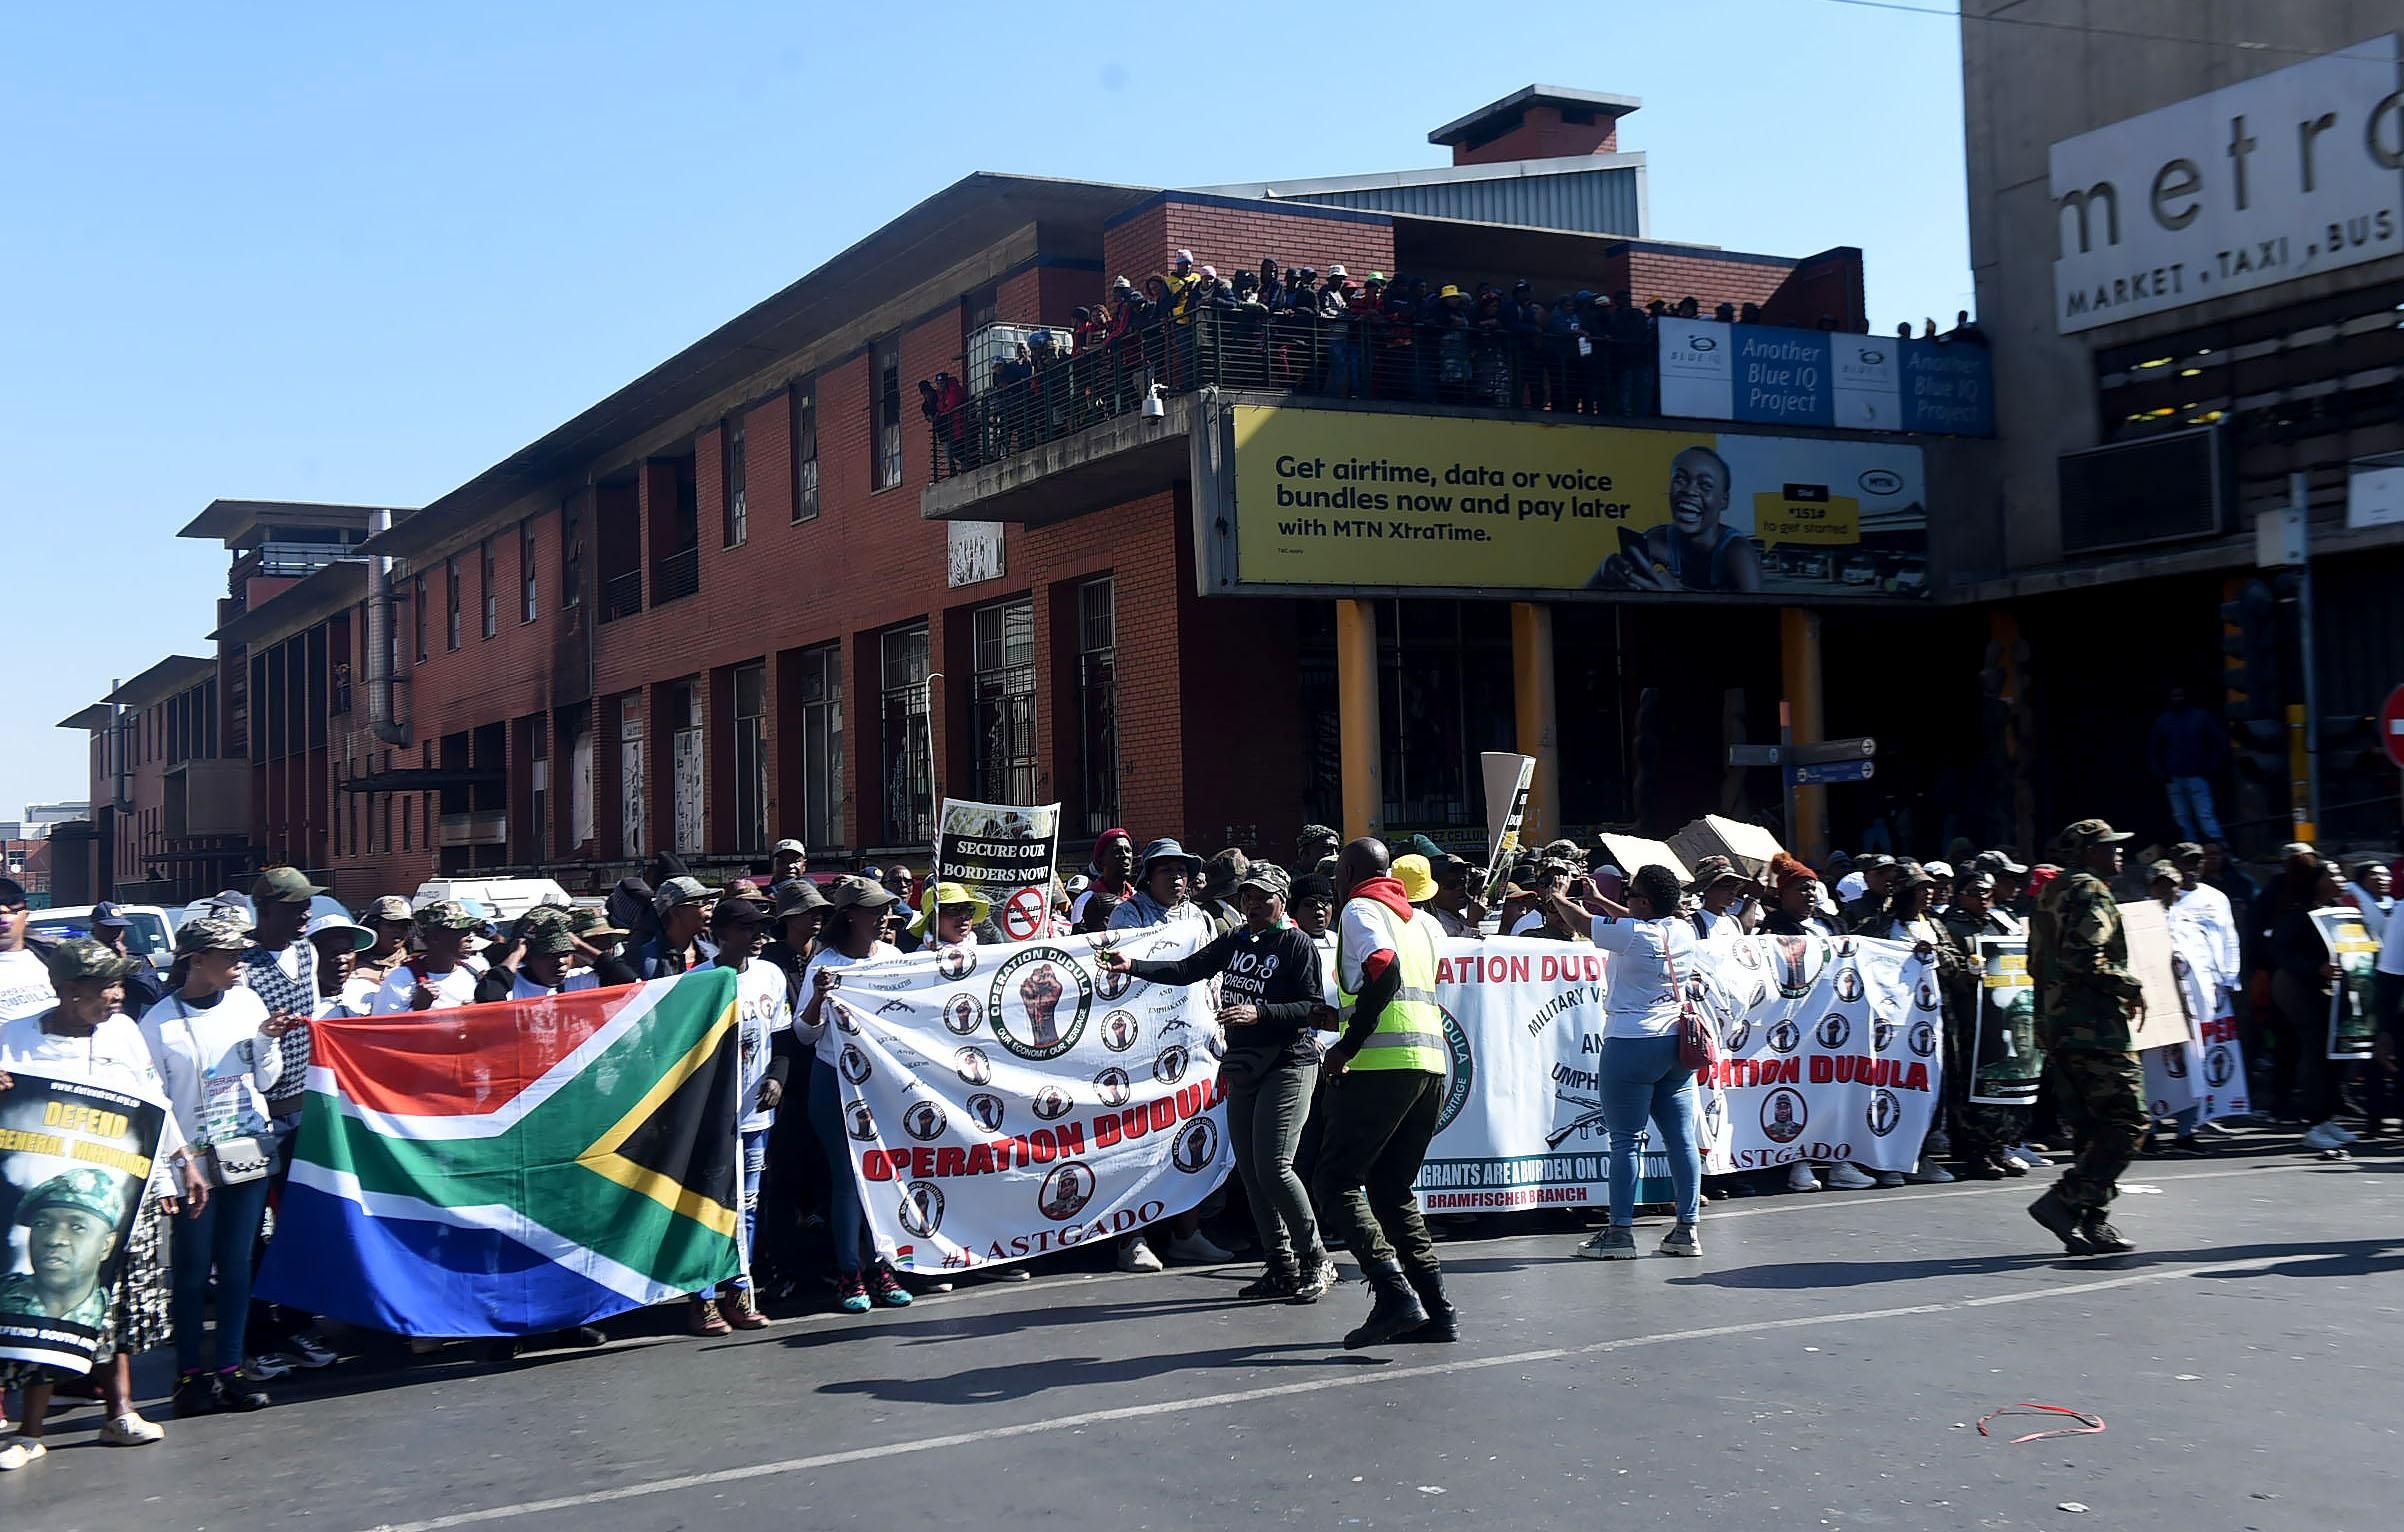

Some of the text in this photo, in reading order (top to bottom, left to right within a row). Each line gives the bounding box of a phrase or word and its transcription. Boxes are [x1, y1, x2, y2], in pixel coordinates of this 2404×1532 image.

[2051, 88, 2404, 255] metro
[2066, 209, 2394, 318] MARKET TAXI BUS
[1742, 337, 1821, 364] Another
[1747, 363, 1789, 387] Blue
[1795, 367, 1818, 391] IQ
[1750, 387, 1817, 417] Project
[1275, 455, 1613, 492] Get airtime, data or voice
[1276, 484, 1632, 523] bundles now and pay later
[1278, 517, 1493, 543] with MTN XtraTime.
[957, 840, 1046, 858] SECURE OUR
[942, 862, 1016, 881] BORDERS
[1227, 949, 1273, 979] NO TO
[1436, 955, 1602, 985] ATION DUD
[991, 948, 1043, 1017] OPERATION
[1048, 950, 1090, 997] DUDULA
[1224, 972, 1265, 994] OREIGN
[1528, 986, 1585, 1039] MILITARY
[997, 1008, 1087, 1057] OUR ECONOMY OUR HERITAGE
[1442, 1014, 1469, 1064] DULA
[1581, 1033, 1604, 1054] AN
[1808, 1055, 1930, 1093] DUDULA
[44, 1101, 128, 1138] DEFEND
[863, 1121, 1086, 1182] OPERATION
[1093, 1074, 1230, 1150] DUDULA
[1729, 1142, 1852, 1168] ASTGADO
[1412, 1163, 1480, 1188] IGRANTS
[1483, 1163, 1511, 1186] ARE
[1512, 1163, 1520, 1184] A
[1520, 1157, 1572, 1183] BURDEN
[1575, 1156, 1597, 1180] ON
[1427, 1186, 1587, 1209] BRAMFISCHER BRANCH
[941, 1200, 1165, 1269] #LASTGADO
